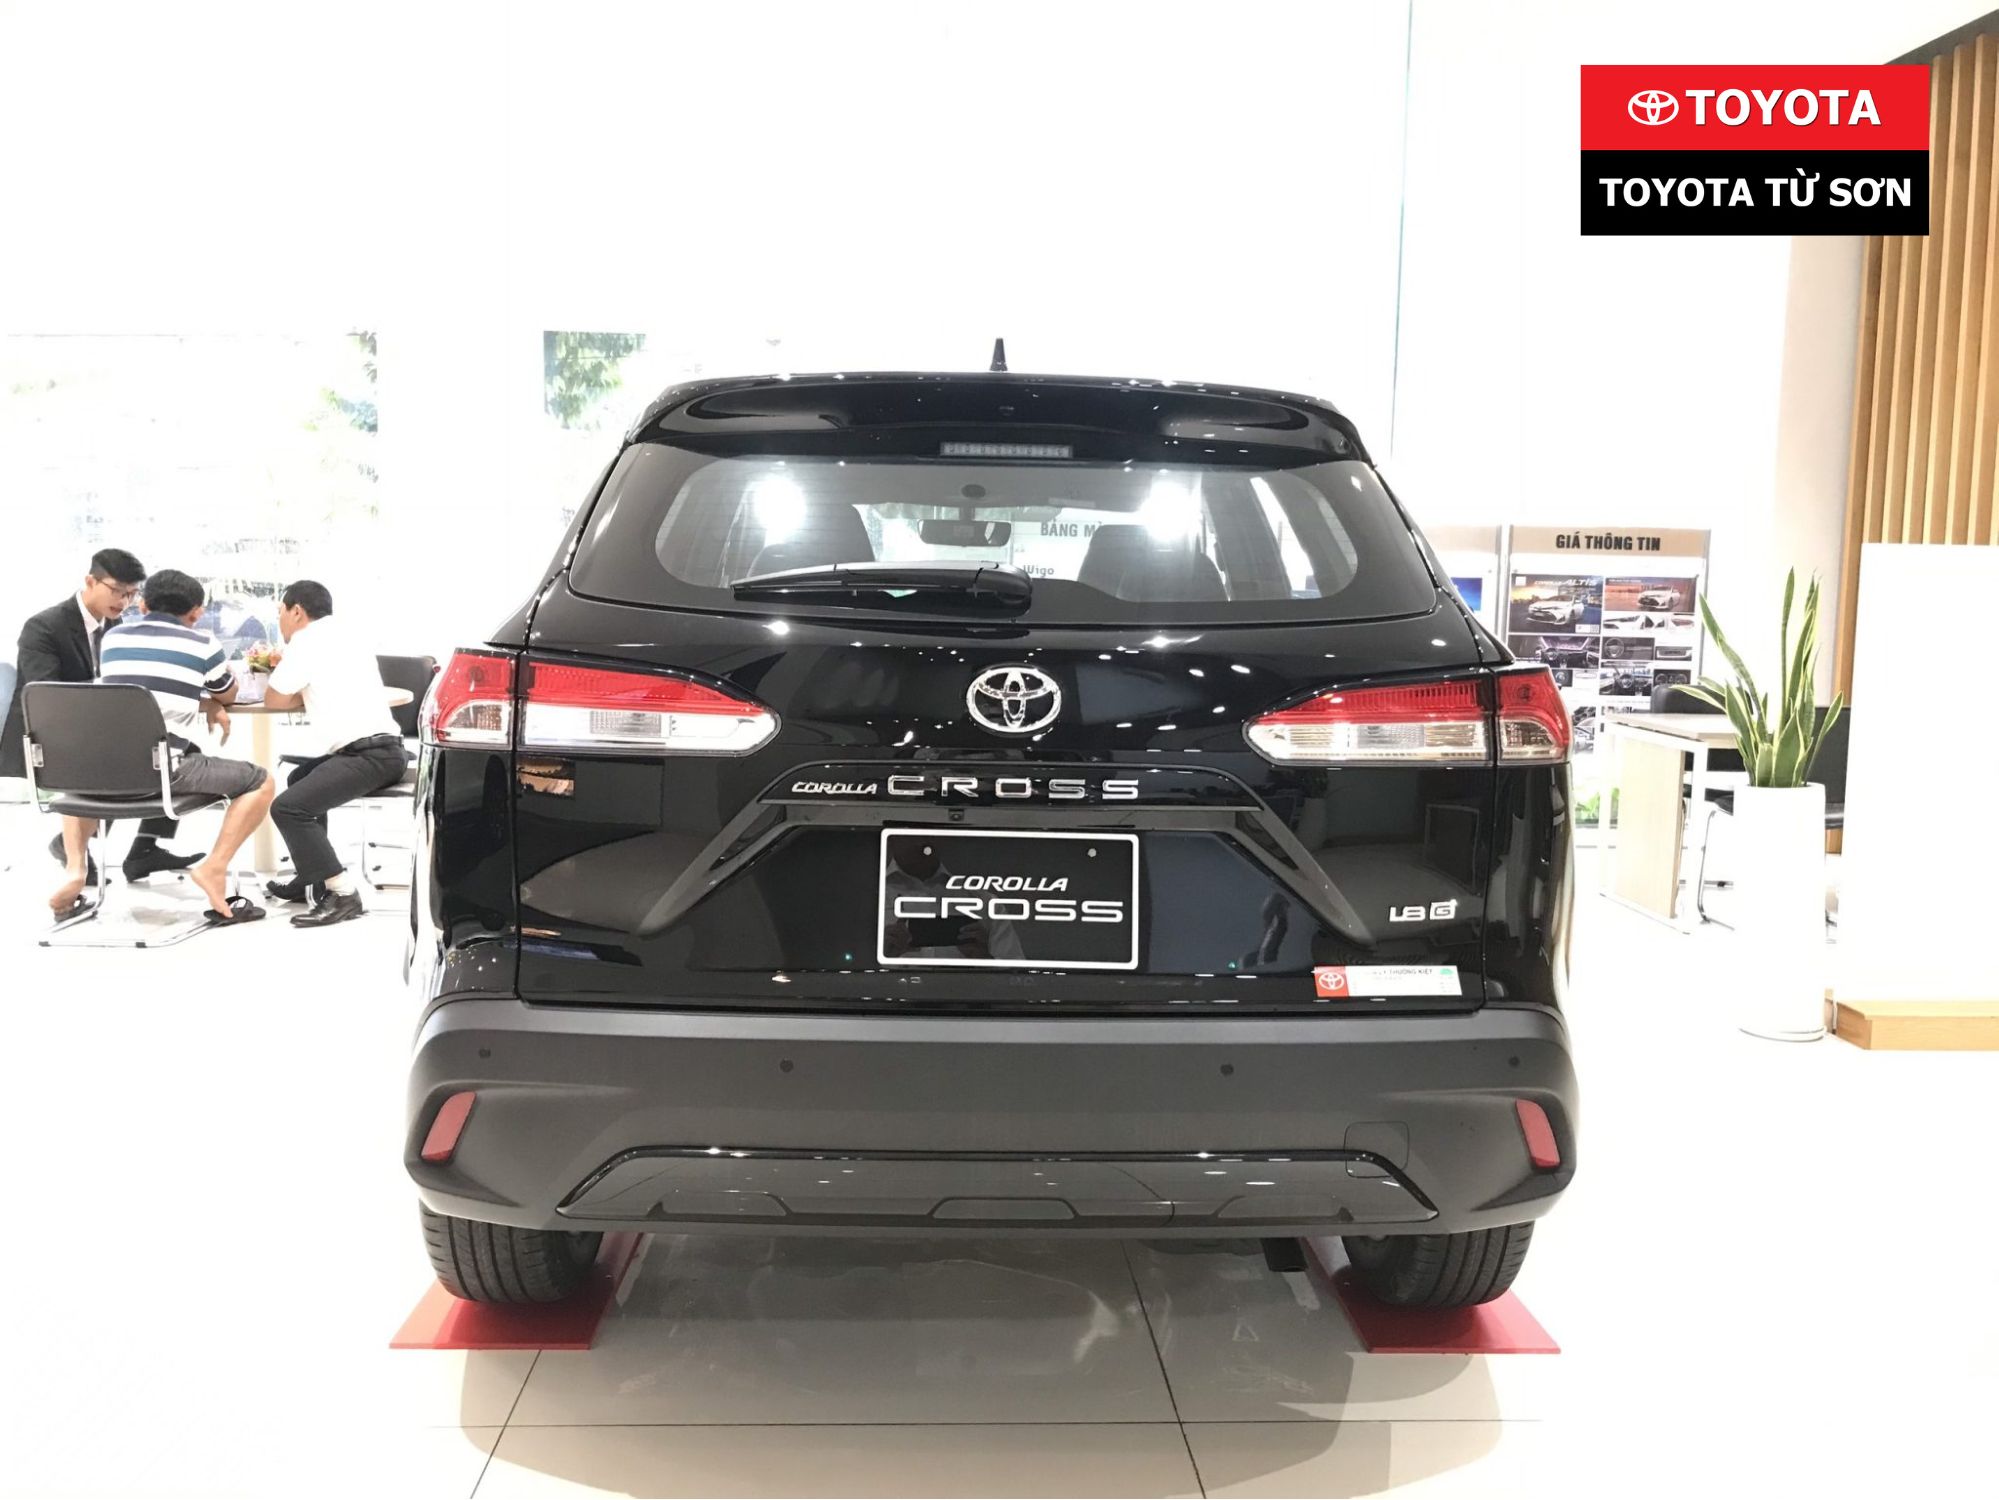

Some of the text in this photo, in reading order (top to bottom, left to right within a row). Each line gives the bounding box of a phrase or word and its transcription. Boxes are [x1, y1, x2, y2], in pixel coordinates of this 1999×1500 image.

[1040, 518, 1078, 537] BẢNG
[1556, 531, 1661, 551] GIÁ THÔNG TIN
[791, 774, 1140, 800] COROLLA CROSS
[945, 875, 1069, 892] COROLLA
[893, 896, 1124, 923] CROSS
